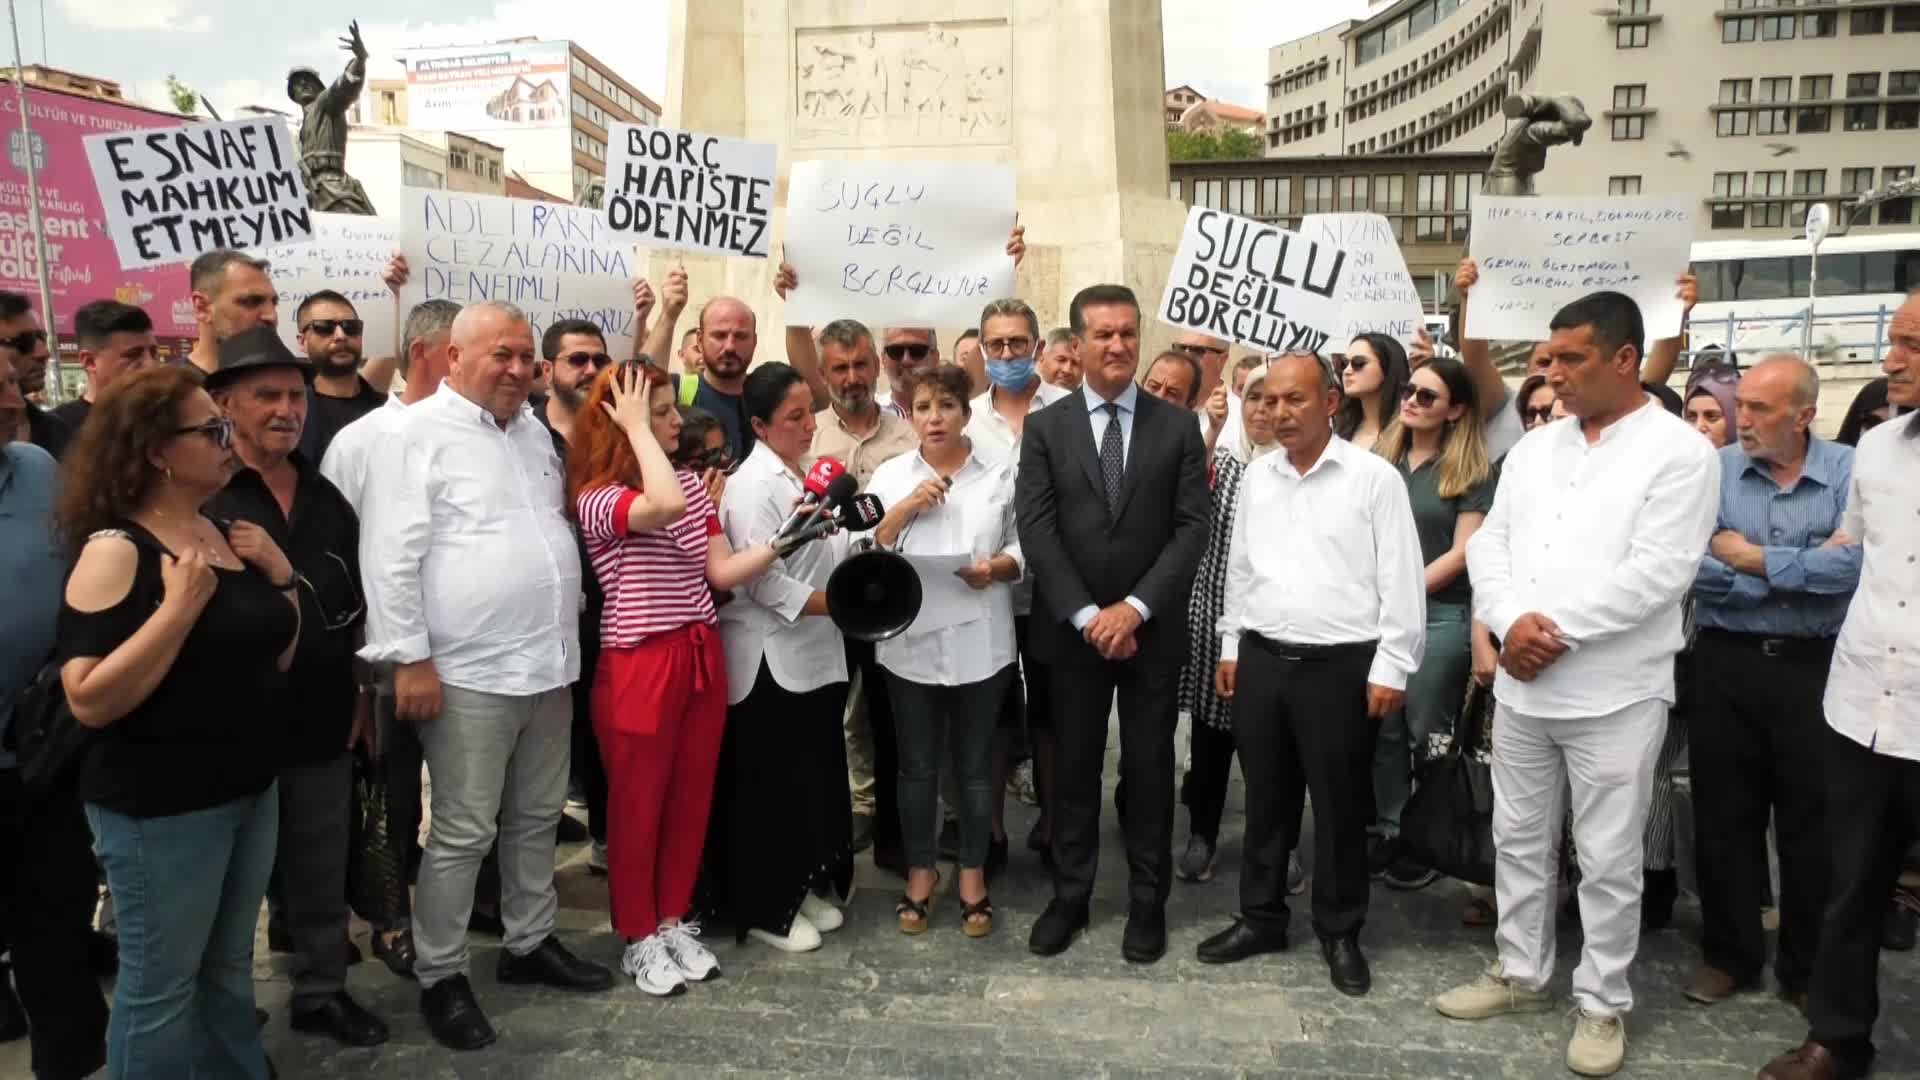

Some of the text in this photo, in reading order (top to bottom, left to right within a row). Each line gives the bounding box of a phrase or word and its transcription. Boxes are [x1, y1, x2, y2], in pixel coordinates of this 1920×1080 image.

[105, 125, 282, 182] ESNAFI
[628, 128, 720, 174] BORÇ
[121, 171, 298, 217] MAHKUM
[624, 162, 770, 216] HAPİSTE
[132, 205, 311, 260] ETMEYİN
[609, 188, 768, 258] ÖDENMEZ
